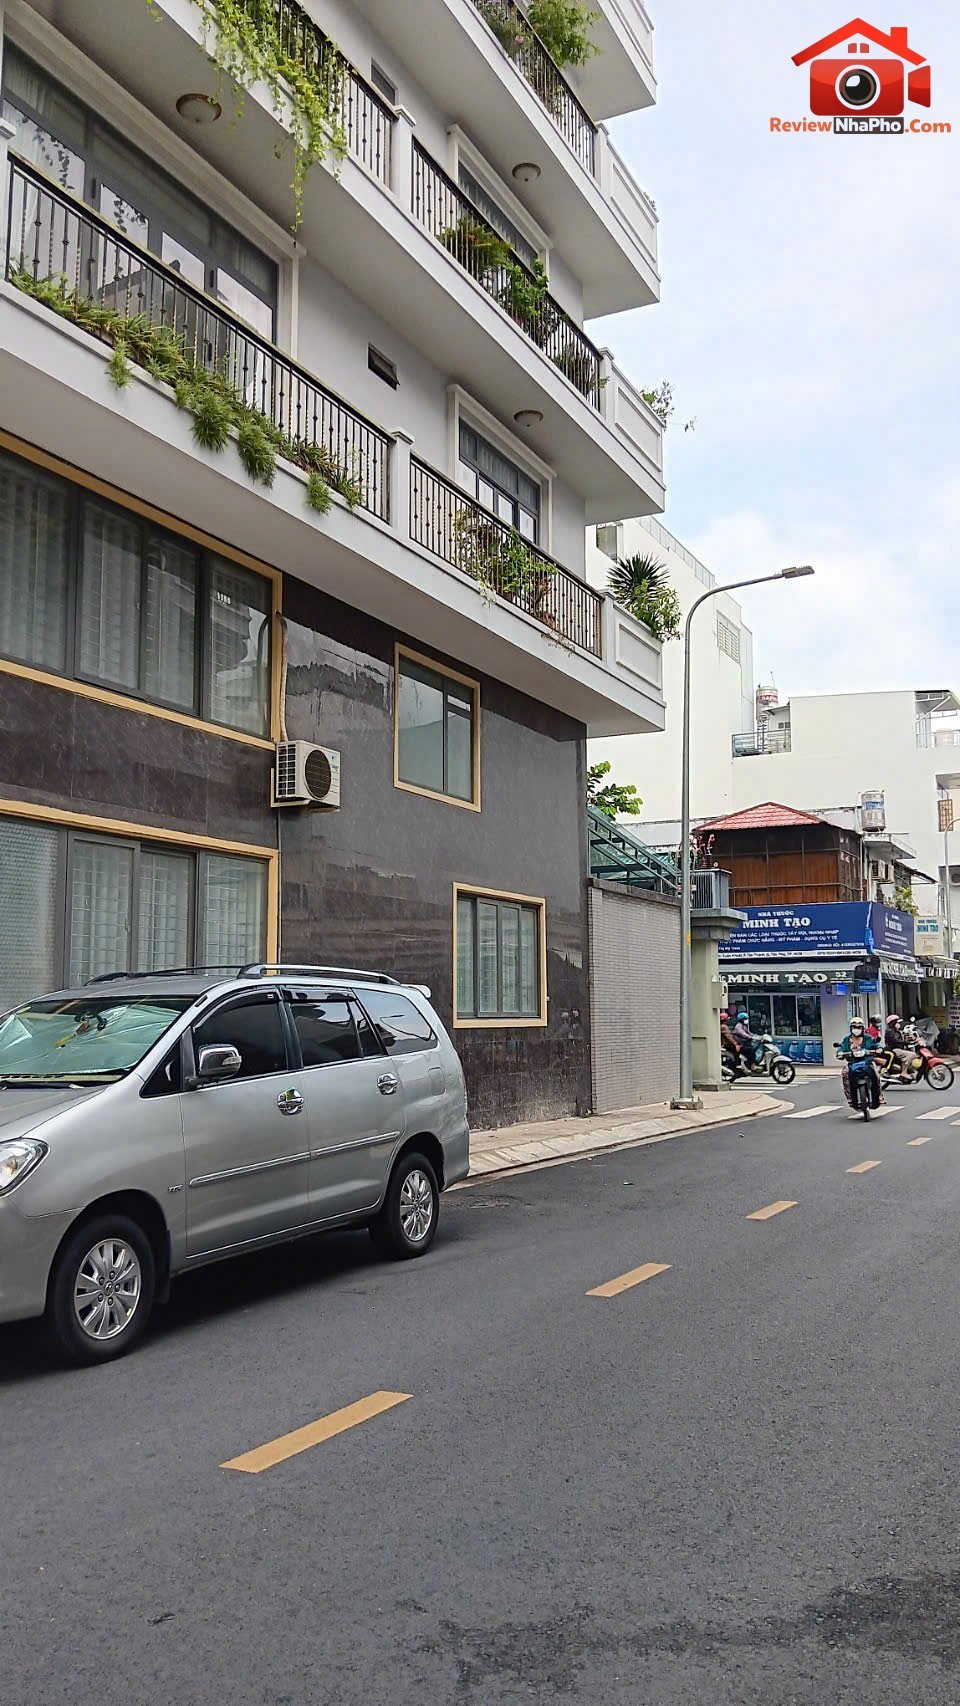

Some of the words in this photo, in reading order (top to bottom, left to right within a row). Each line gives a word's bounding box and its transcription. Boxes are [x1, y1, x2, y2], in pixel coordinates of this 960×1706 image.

[742, 918, 779, 929] MINH
[783, 917, 811, 929] TẠO
[727, 974, 780, 983] MINH
[785, 973, 828, 985] TẠO
